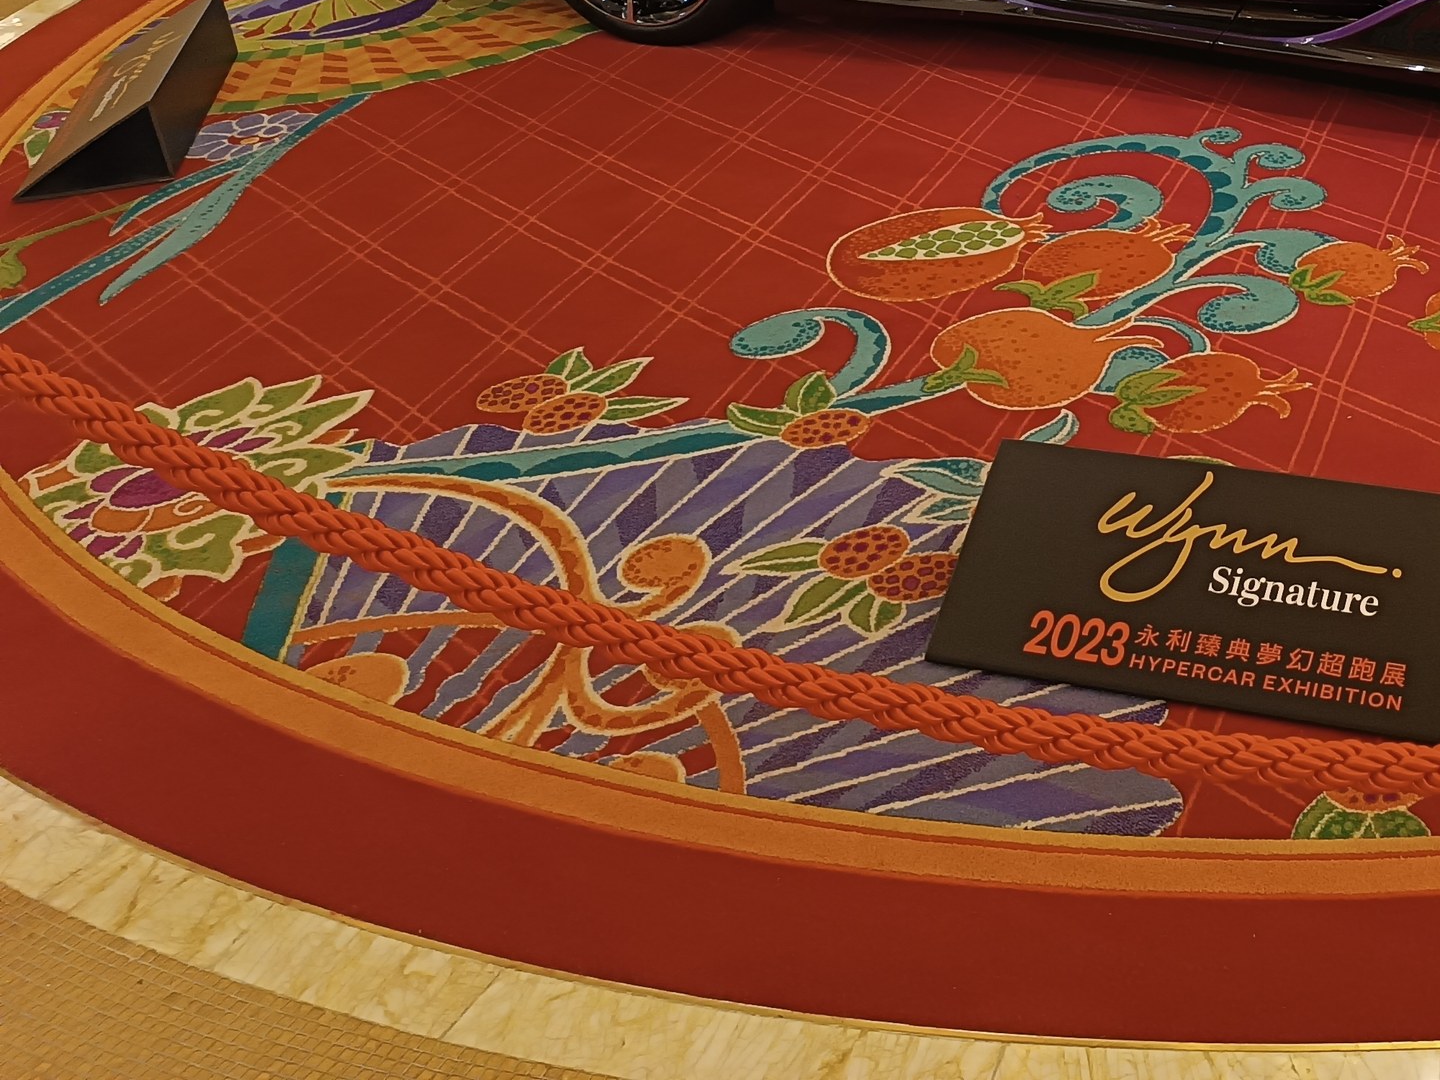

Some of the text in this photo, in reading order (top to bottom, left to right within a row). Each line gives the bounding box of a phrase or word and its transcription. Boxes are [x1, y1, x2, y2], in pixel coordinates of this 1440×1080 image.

[1208, 566, 1379, 616] Signature
[1023, 609, 1407, 688] 2023 永利臻典夢幻超跑展
[1129, 653, 1403, 712] HYPERCAR EXHIBITION
